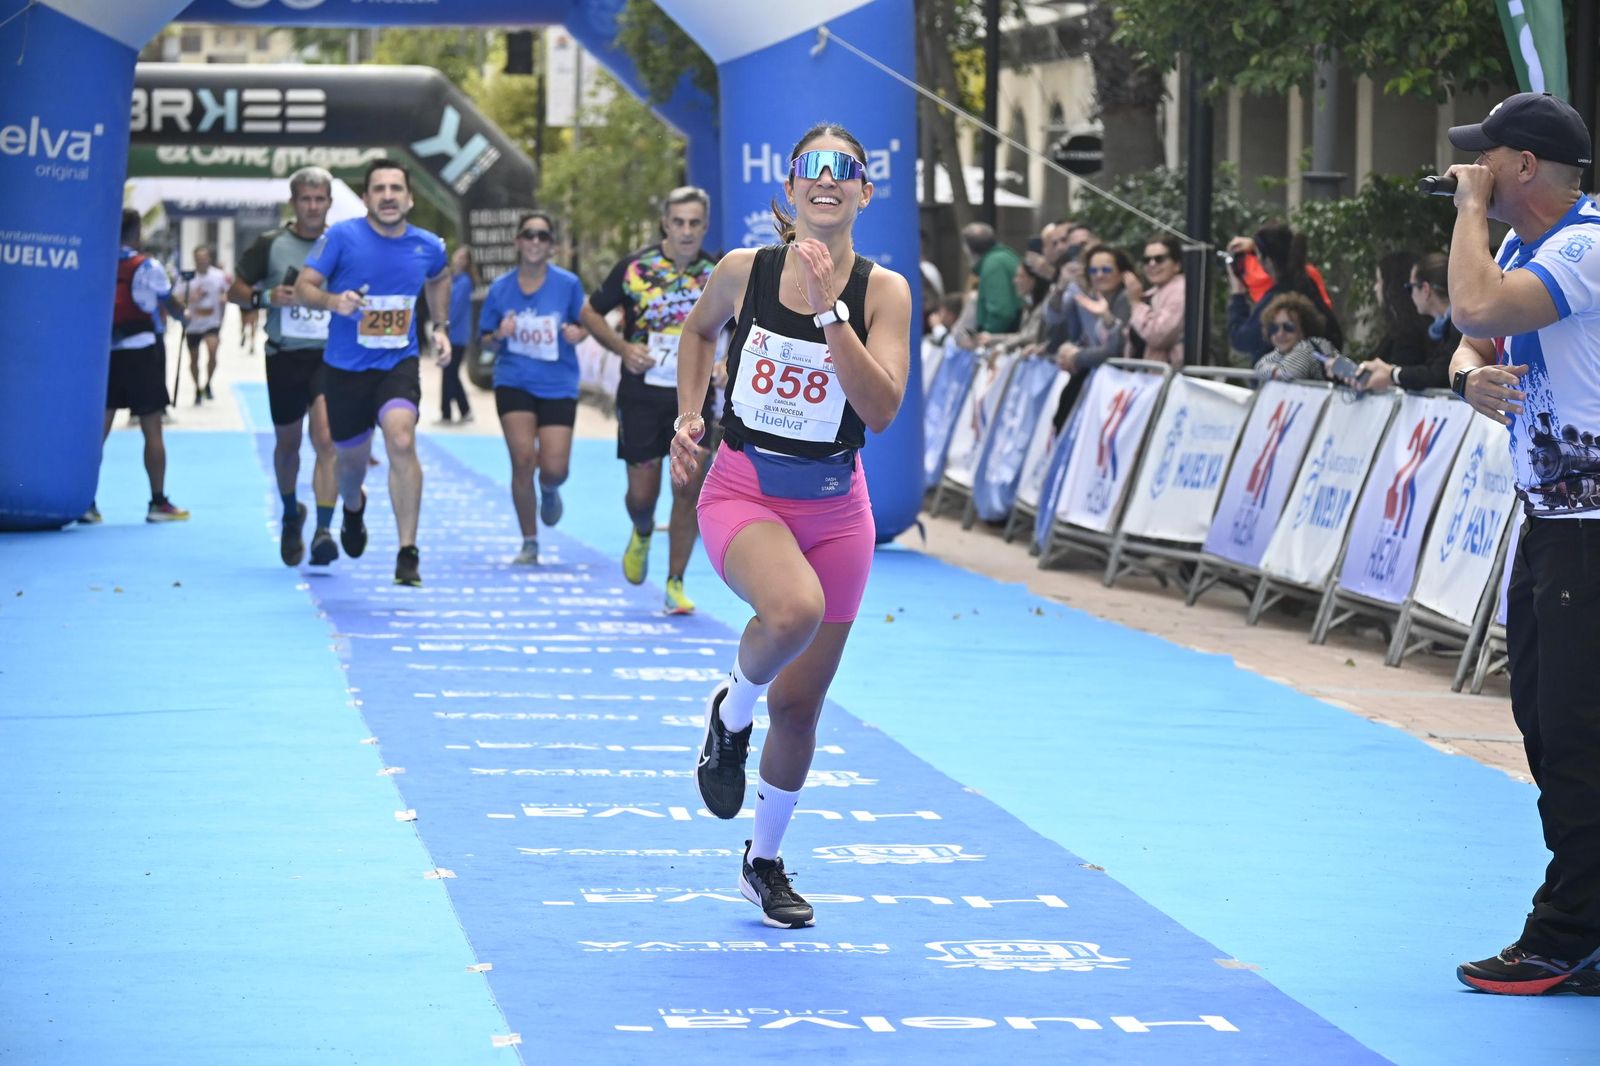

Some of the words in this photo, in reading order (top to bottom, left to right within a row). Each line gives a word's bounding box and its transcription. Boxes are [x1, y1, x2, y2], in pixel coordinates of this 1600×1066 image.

[36, 164, 89, 182] original
[368, 310, 406, 328] 298
[752, 331, 771, 352] 2K
[752, 359, 829, 405] 858
[764, 404, 780, 413] SILVA
[780, 407, 804, 417] NOCEDA
[774, 399, 796, 407] CAROLINA
[582, 893, 1068, 908] Hueva
[576, 941, 890, 950] HUELVA
[658, 1008, 849, 1016] original
[658, 1015, 1240, 1033] Huelva
